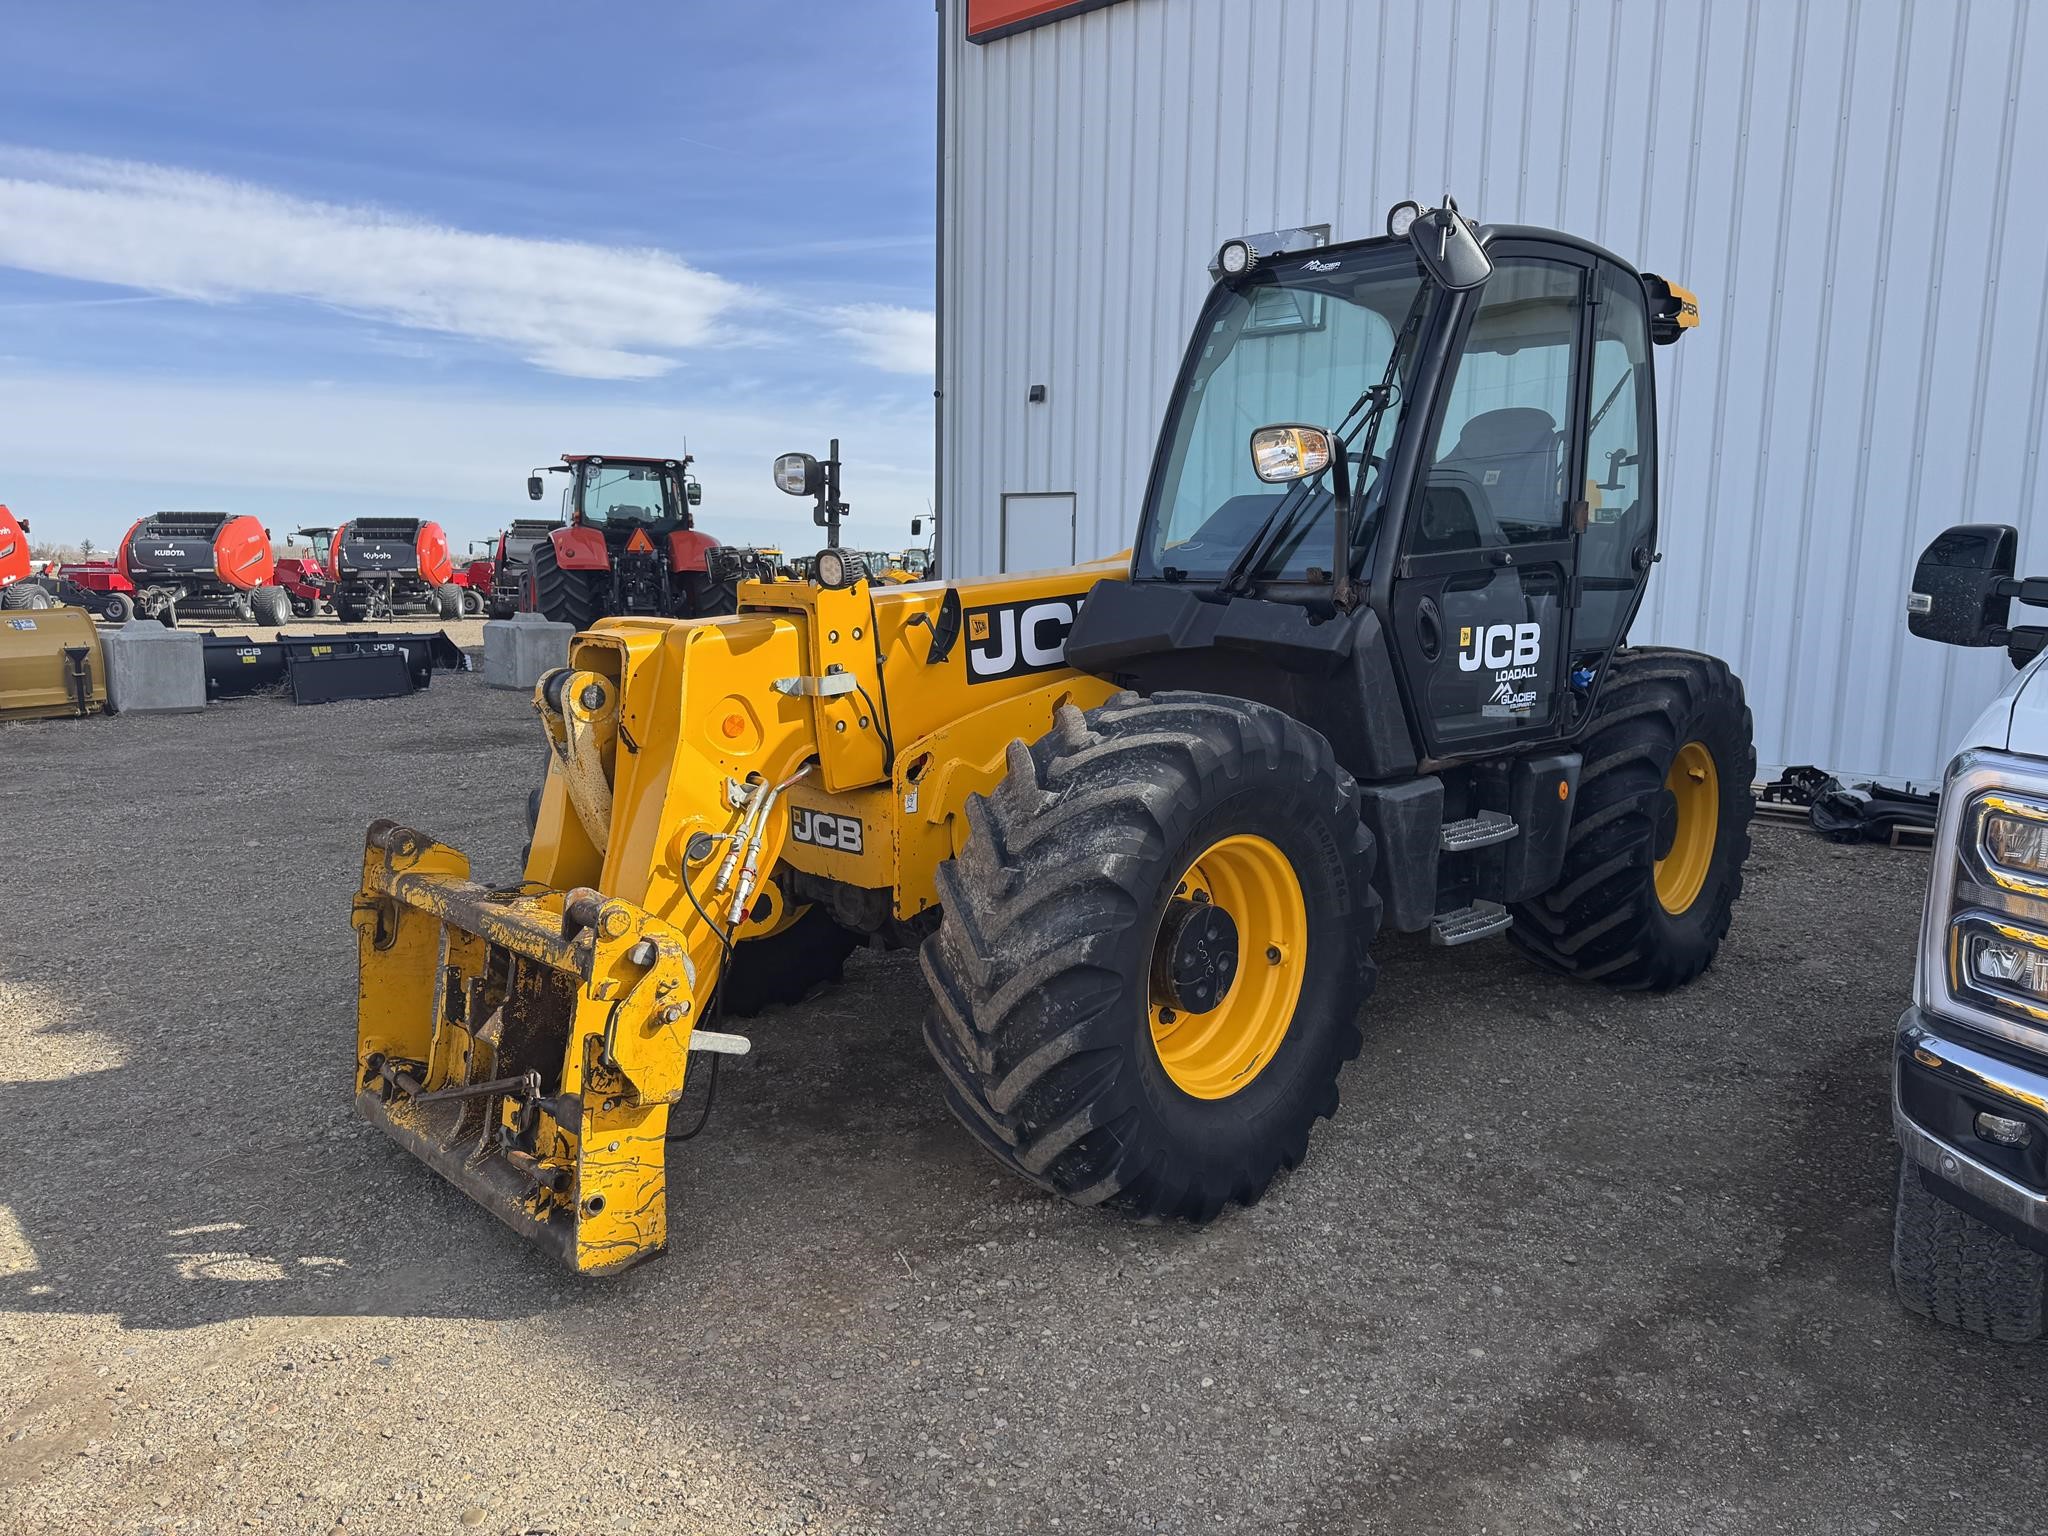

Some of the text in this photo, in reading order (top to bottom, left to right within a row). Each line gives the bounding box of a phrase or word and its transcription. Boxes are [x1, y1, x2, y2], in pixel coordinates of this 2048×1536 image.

[154, 549, 185, 557] KUBOTA
[363, 552, 391, 560] Kubota
[971, 600, 1086, 675] JC
[236, 648, 261, 656] JCB
[1459, 622, 1541, 672] JCB
[1495, 666, 1538, 682] LOADALL
[1501, 692, 1537, 705] GLACIER
[795, 811, 862, 851] JCB
